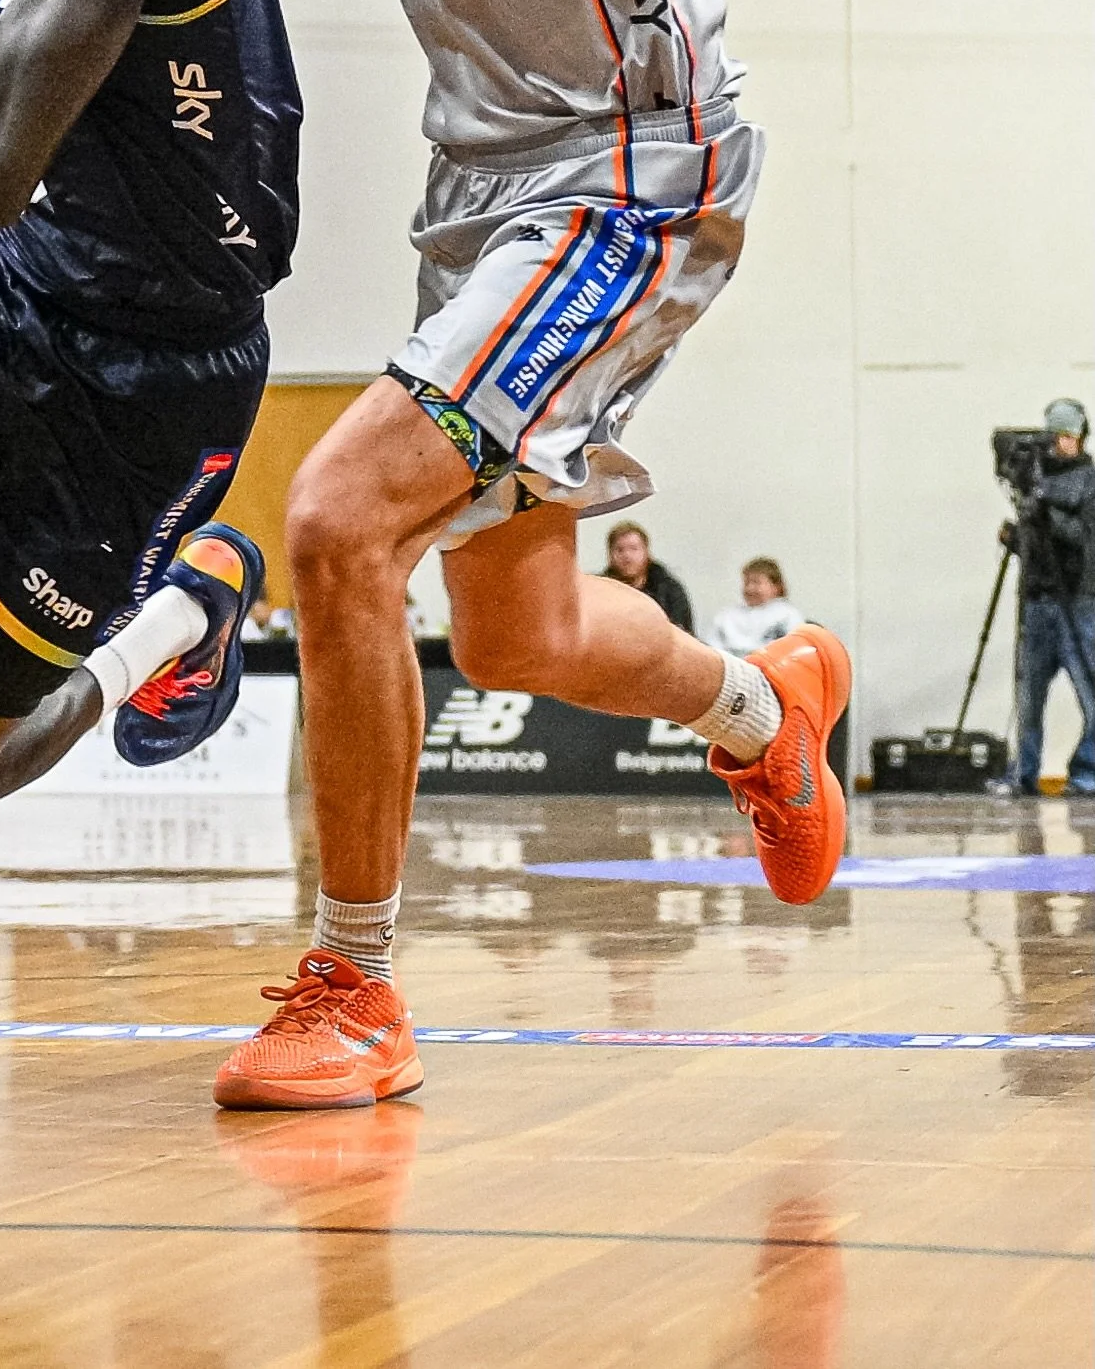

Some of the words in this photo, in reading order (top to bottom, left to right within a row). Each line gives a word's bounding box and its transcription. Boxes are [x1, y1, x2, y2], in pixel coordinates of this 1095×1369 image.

[507, 278, 607, 400] WAREHOUSE
[22, 567, 94, 630] Sharp
[451, 748, 548, 772] balance
